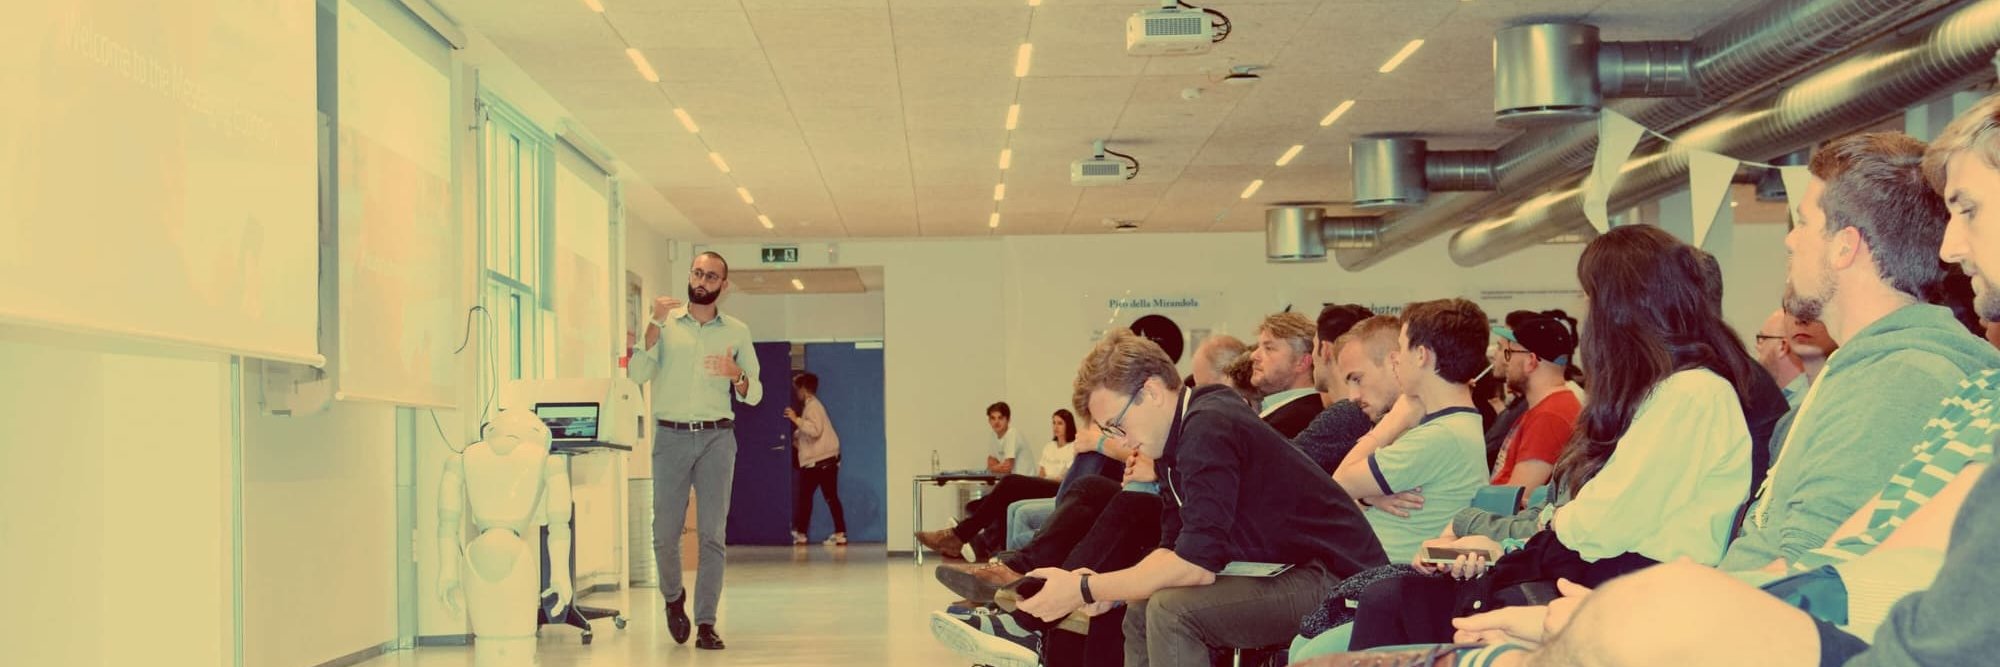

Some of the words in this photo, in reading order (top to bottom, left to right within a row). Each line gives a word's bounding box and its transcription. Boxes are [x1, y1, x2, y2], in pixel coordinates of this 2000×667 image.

[64, 9, 130, 78] Welcome
[131, 45, 146, 85] to
[148, 56, 170, 98] the
[1109, 299, 1128, 308] Pico
[1130, 299, 1151, 308] della
[1153, 298, 1198, 308] Mirandola
